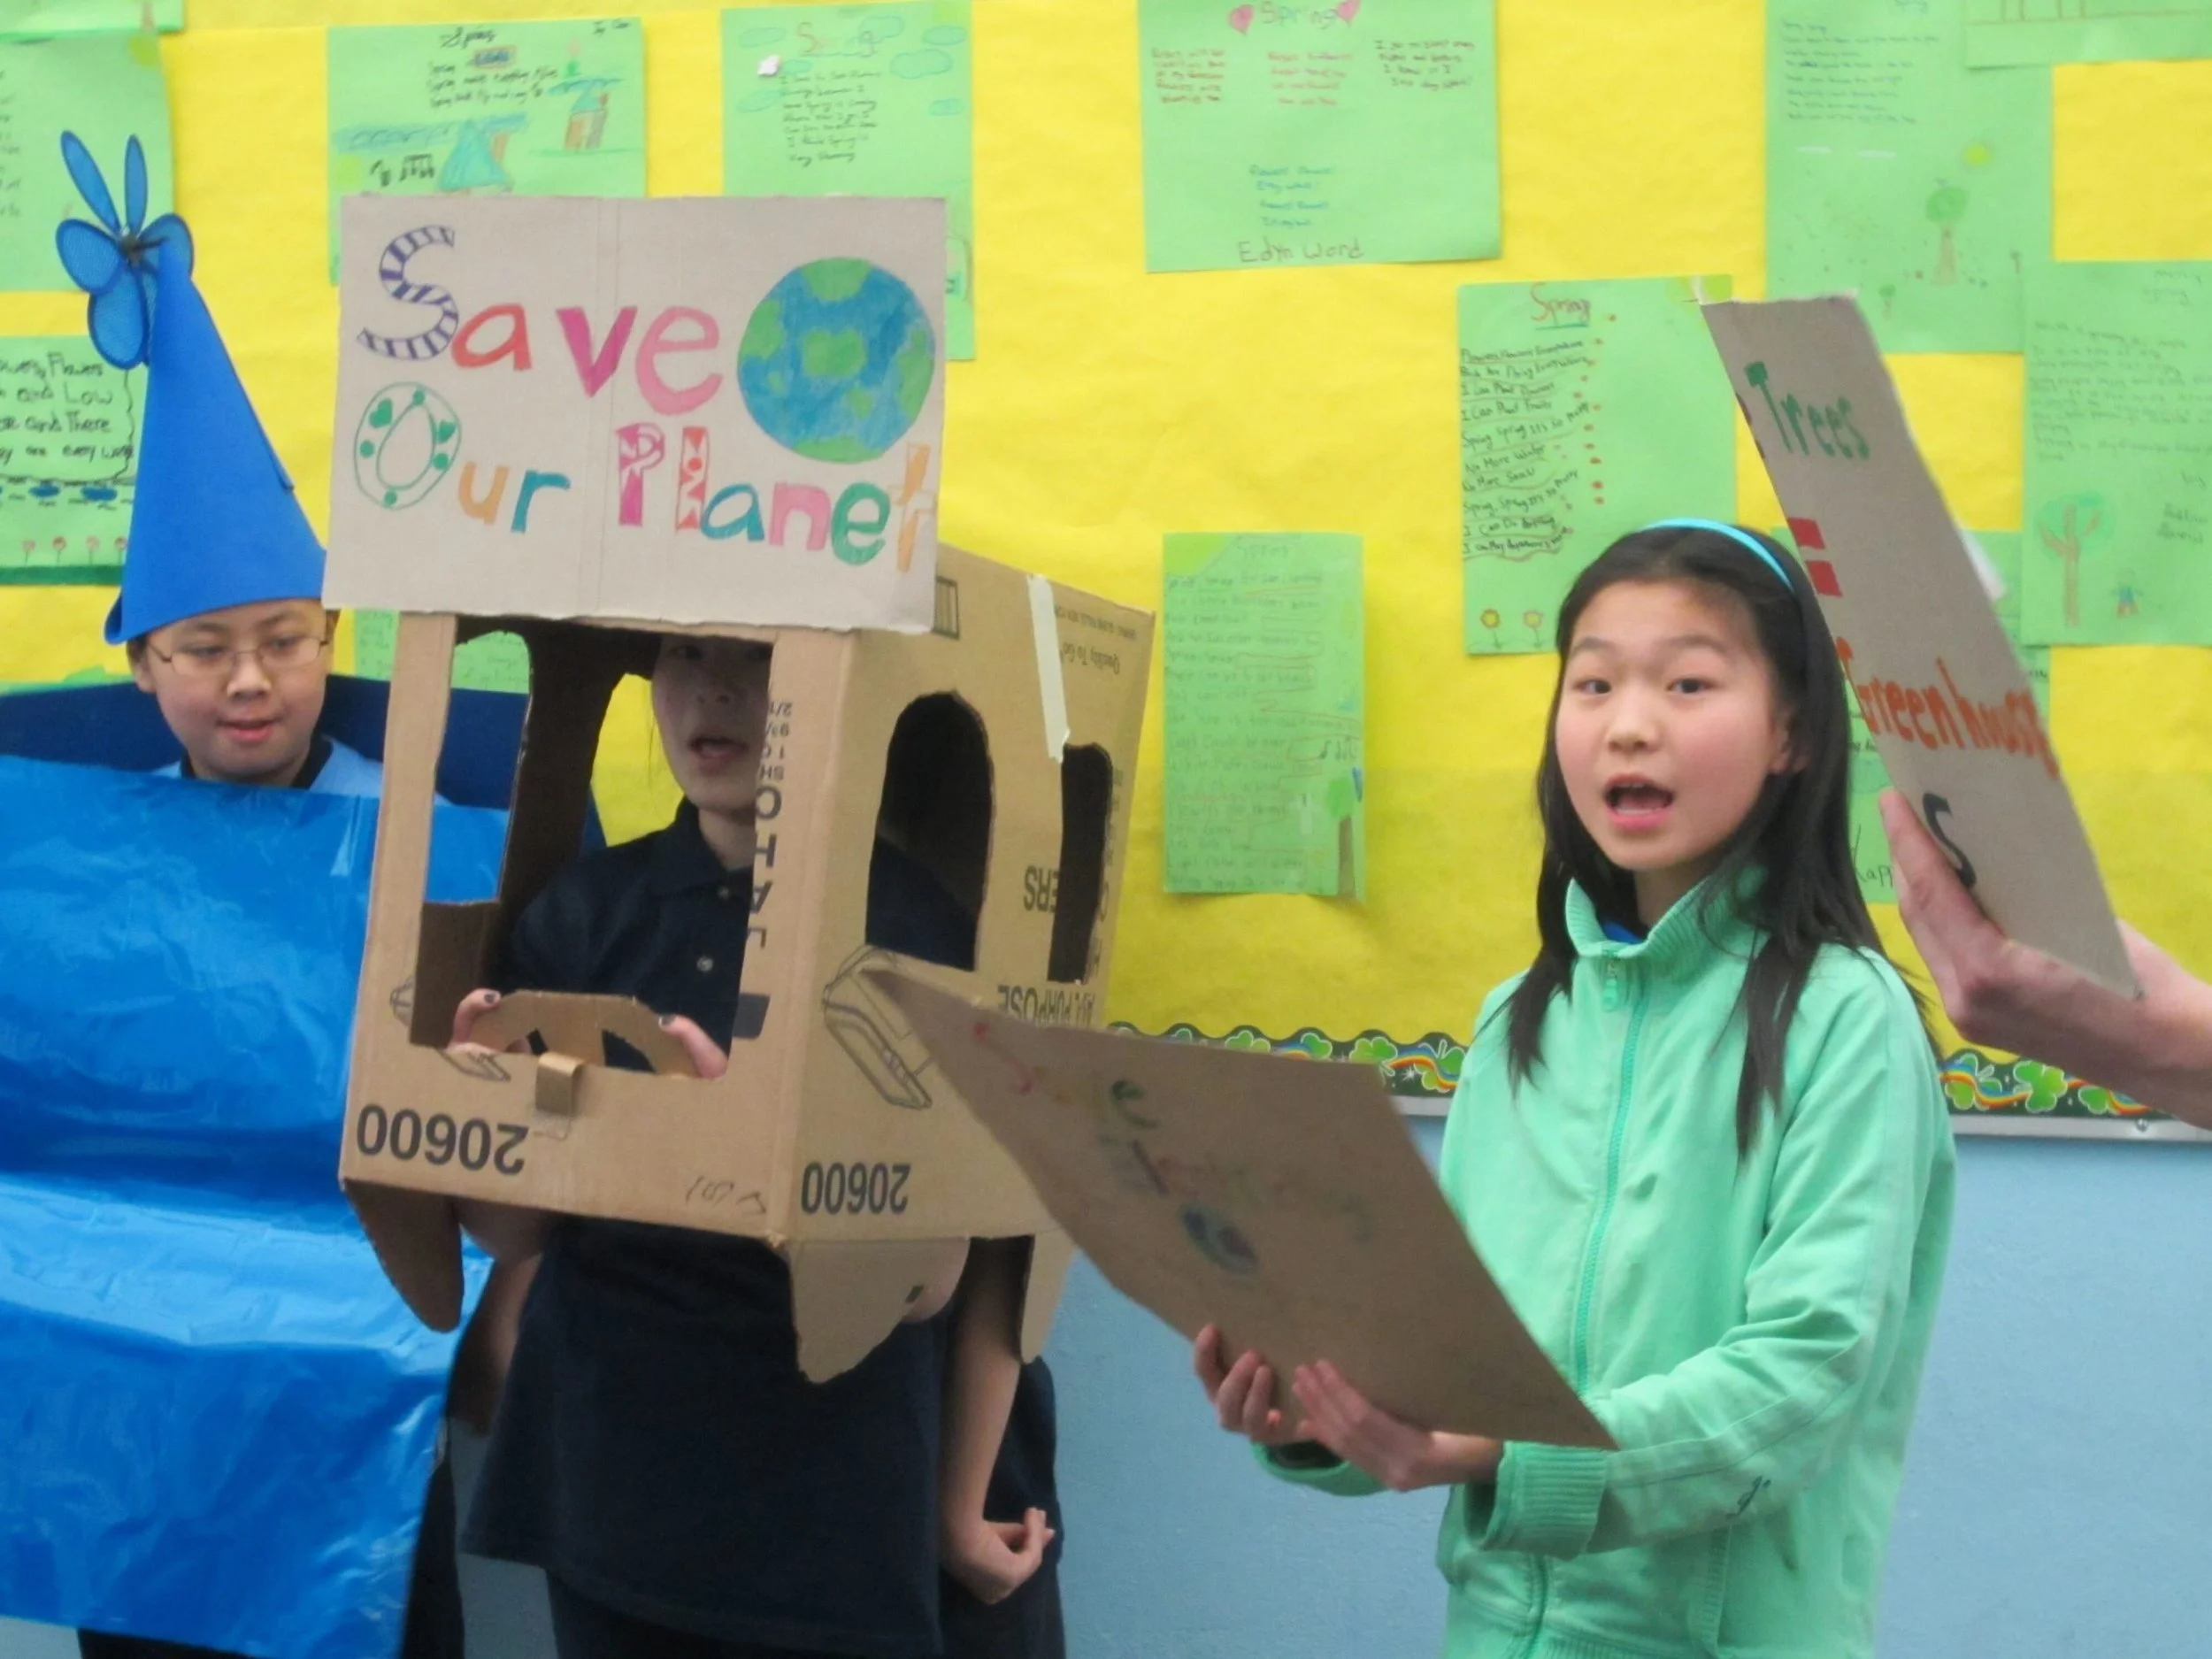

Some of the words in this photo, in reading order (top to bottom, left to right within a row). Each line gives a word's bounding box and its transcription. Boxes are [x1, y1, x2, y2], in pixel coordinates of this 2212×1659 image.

[357, 225, 723, 415] Save
[1743, 360, 1870, 459] Trees
[353, 380, 571, 534] Our
[616, 422, 937, 573] Planet
[356, 1102, 530, 1176] 20600
[801, 1161, 911, 1217] 20600
